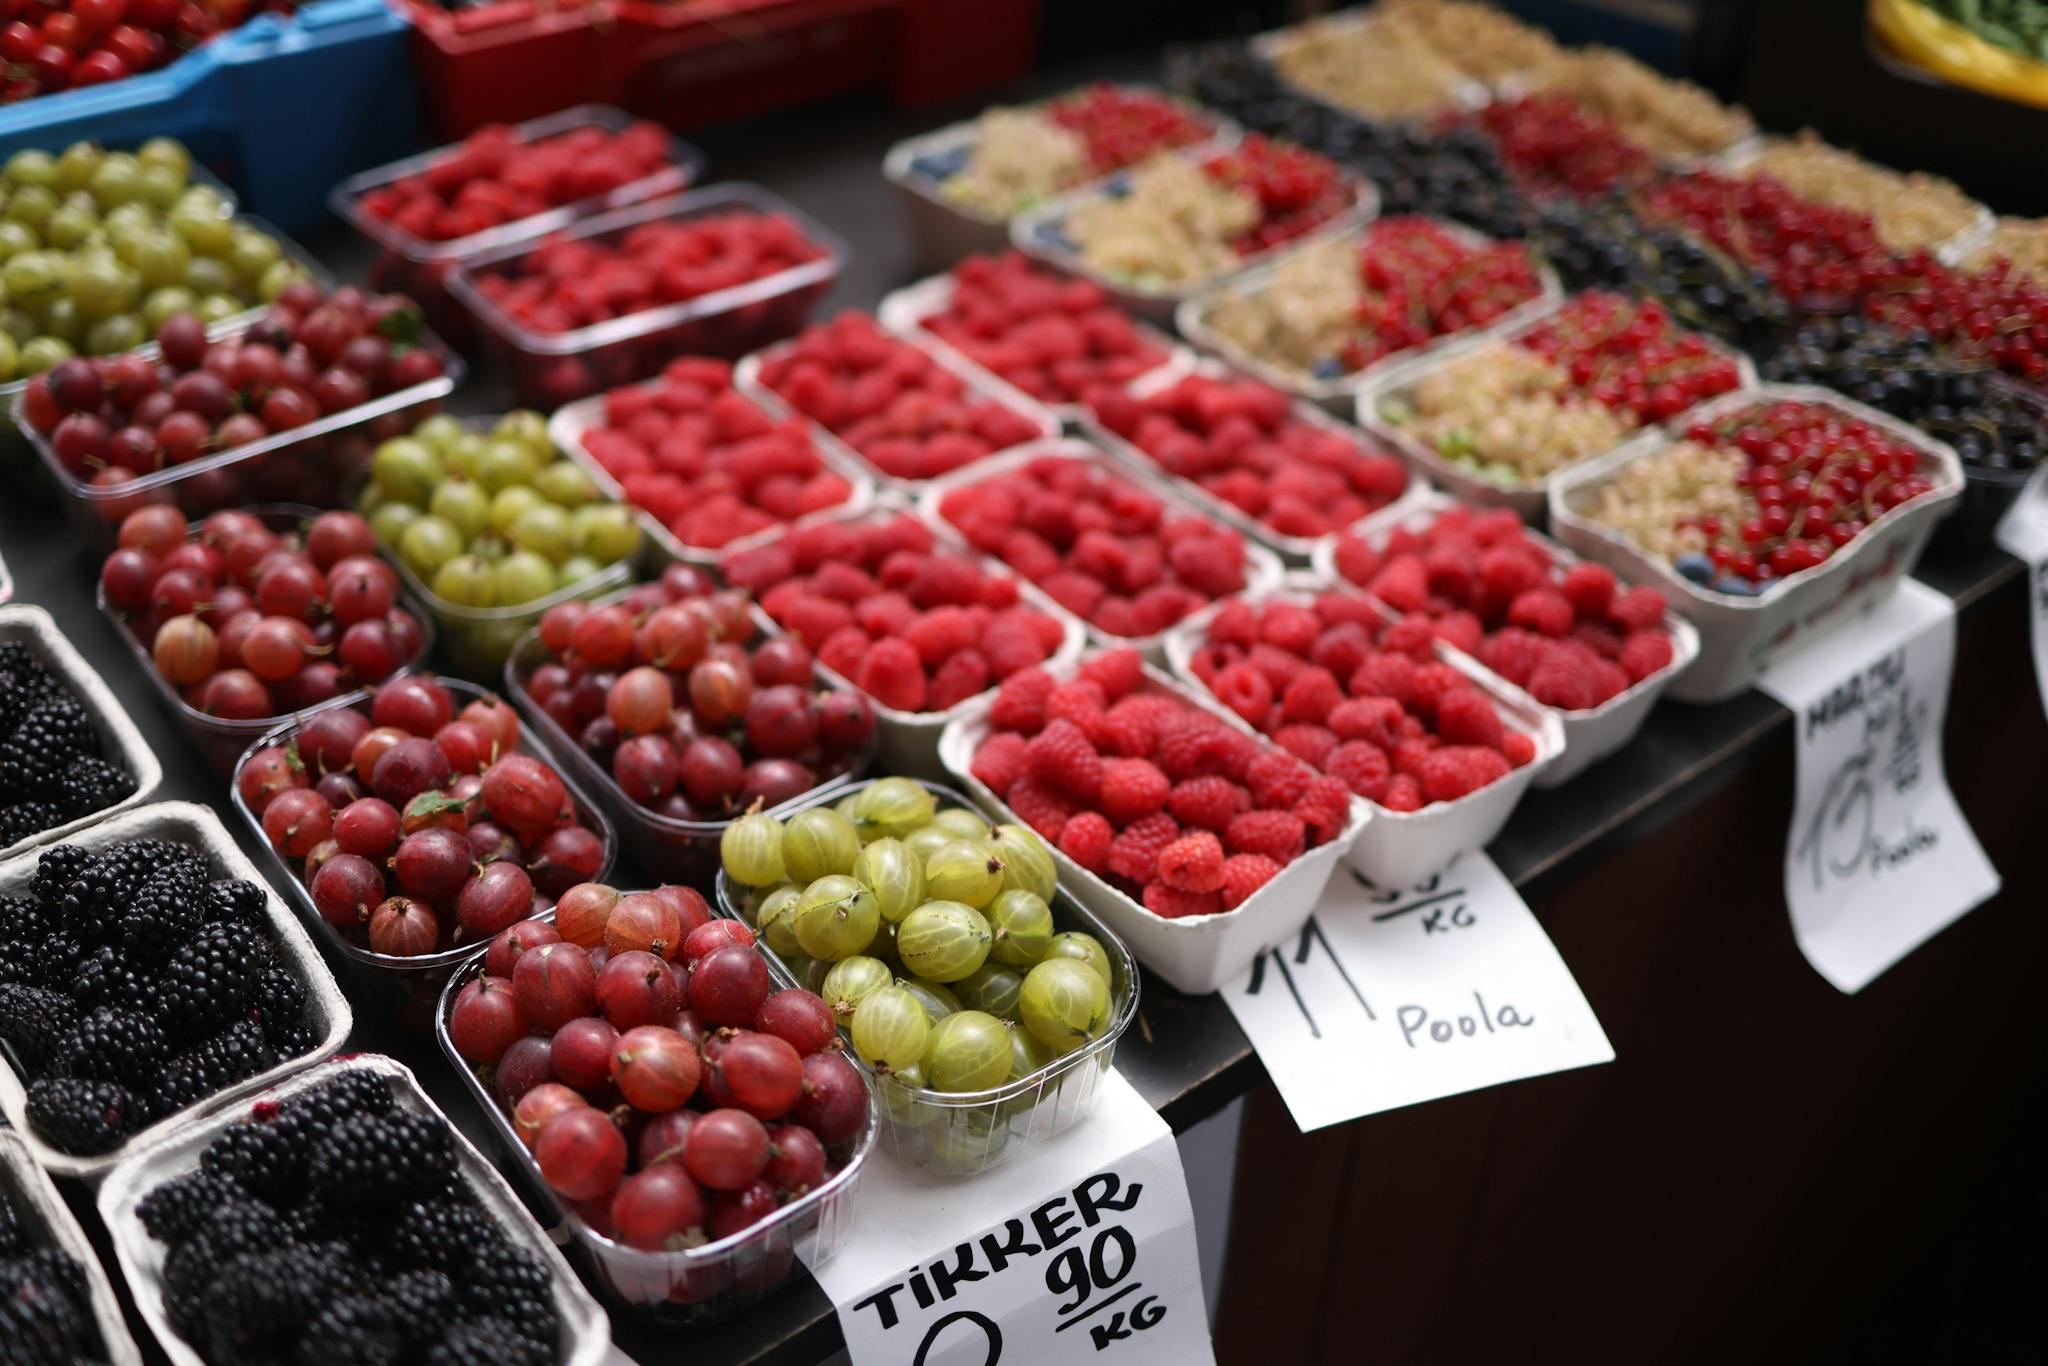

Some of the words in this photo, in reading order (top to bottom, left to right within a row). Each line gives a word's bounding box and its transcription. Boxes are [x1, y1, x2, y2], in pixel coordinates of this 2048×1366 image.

[1421, 903, 1477, 934] KG
[1245, 911, 1377, 1039] 11
[1397, 990, 1534, 1048] Poola
[1045, 1225, 1137, 1315] 90
[1090, 1295, 1167, 1351] KG
